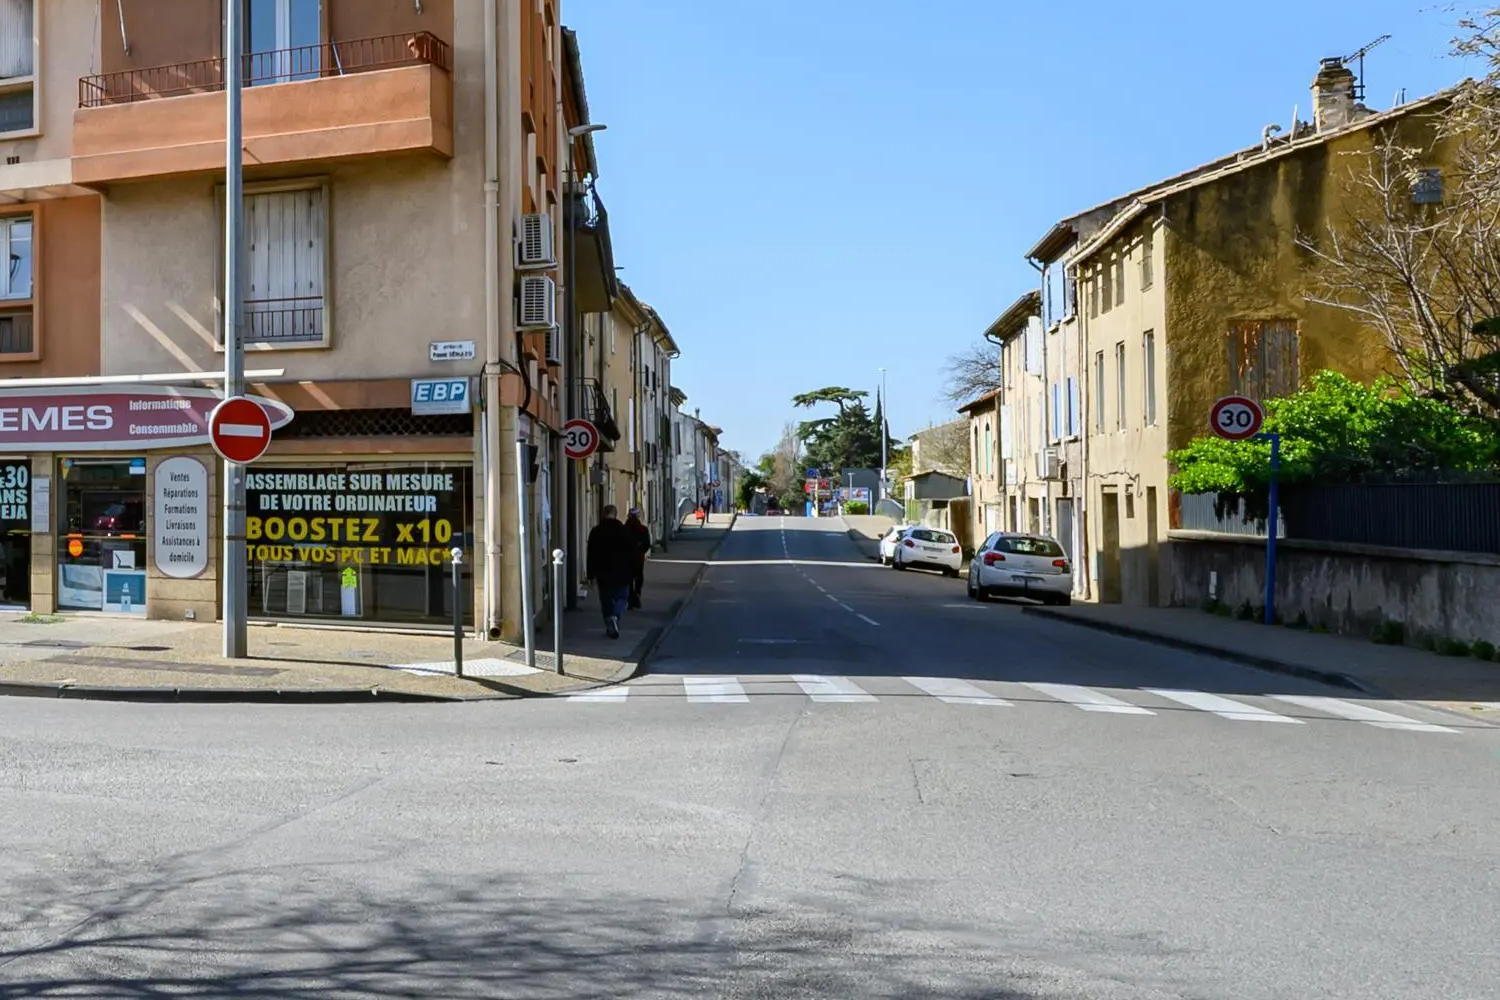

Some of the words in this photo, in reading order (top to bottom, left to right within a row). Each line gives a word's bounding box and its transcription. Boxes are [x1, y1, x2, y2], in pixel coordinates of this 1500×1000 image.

[416, 383, 465, 401] EBP
[129, 399, 192, 411] Informatique
[1221, 409, 1251, 428] 30
[129, 422, 198, 435] Consommable
[566, 431, 590, 447] 30
[5, 465, 28, 489] 30
[170, 472, 190, 482] Ventes
[246, 474, 346, 490] ASSEMBLAGE
[350, 474, 382, 490] SUR
[386, 474, 454, 491] MESURE
[163, 487, 198, 500] Réparations
[164, 504, 198, 514] Formations
[259, 494, 279, 511] DE
[281, 495, 331, 511] VOTRE
[335, 495, 437, 512] ORDINATEUR
[166, 520, 196, 530] Livraisons
[246, 517, 380, 542] BOOSTEZ
[396, 518, 452, 543] x10
[162, 536, 195, 546] Assistances
[169, 551, 195, 562] domicile
[246, 545, 293, 561] TOUS
[298, 545, 336, 562] VOS
[341, 546, 365, 563] PC
[369, 547, 391, 564] ET
